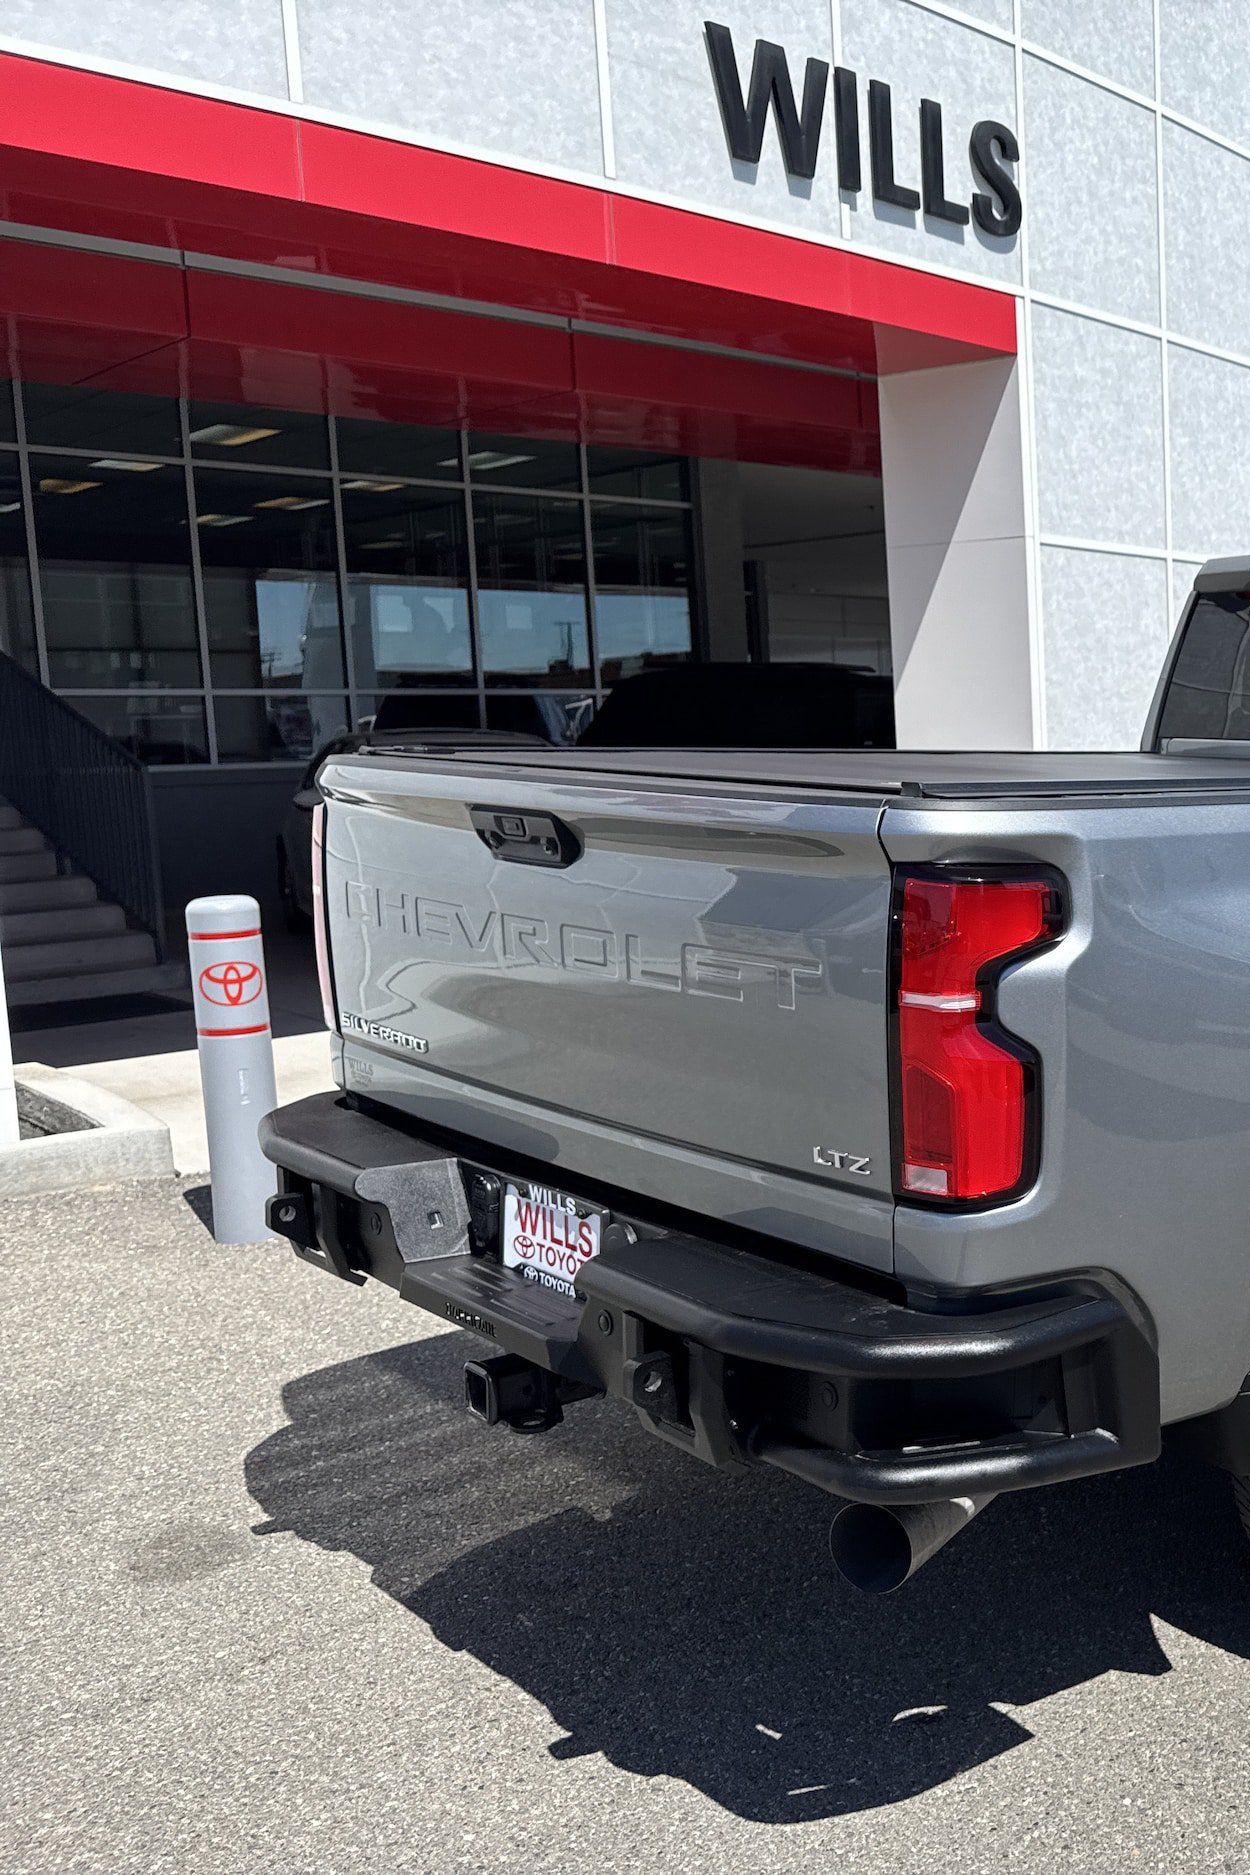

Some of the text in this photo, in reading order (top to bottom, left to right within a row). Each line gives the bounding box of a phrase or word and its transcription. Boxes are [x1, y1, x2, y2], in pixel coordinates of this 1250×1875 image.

[704, 20, 1022, 237] WILLS
[345, 880, 823, 1010] CHEVROLET
[341, 1011, 428, 1054] SILVERADO
[813, 1146, 871, 1175] LTZ
[528, 1184, 577, 1216] WILLS
[517, 1199, 593, 1258] WILLS
[539, 1271, 577, 1299] TOYOTA
